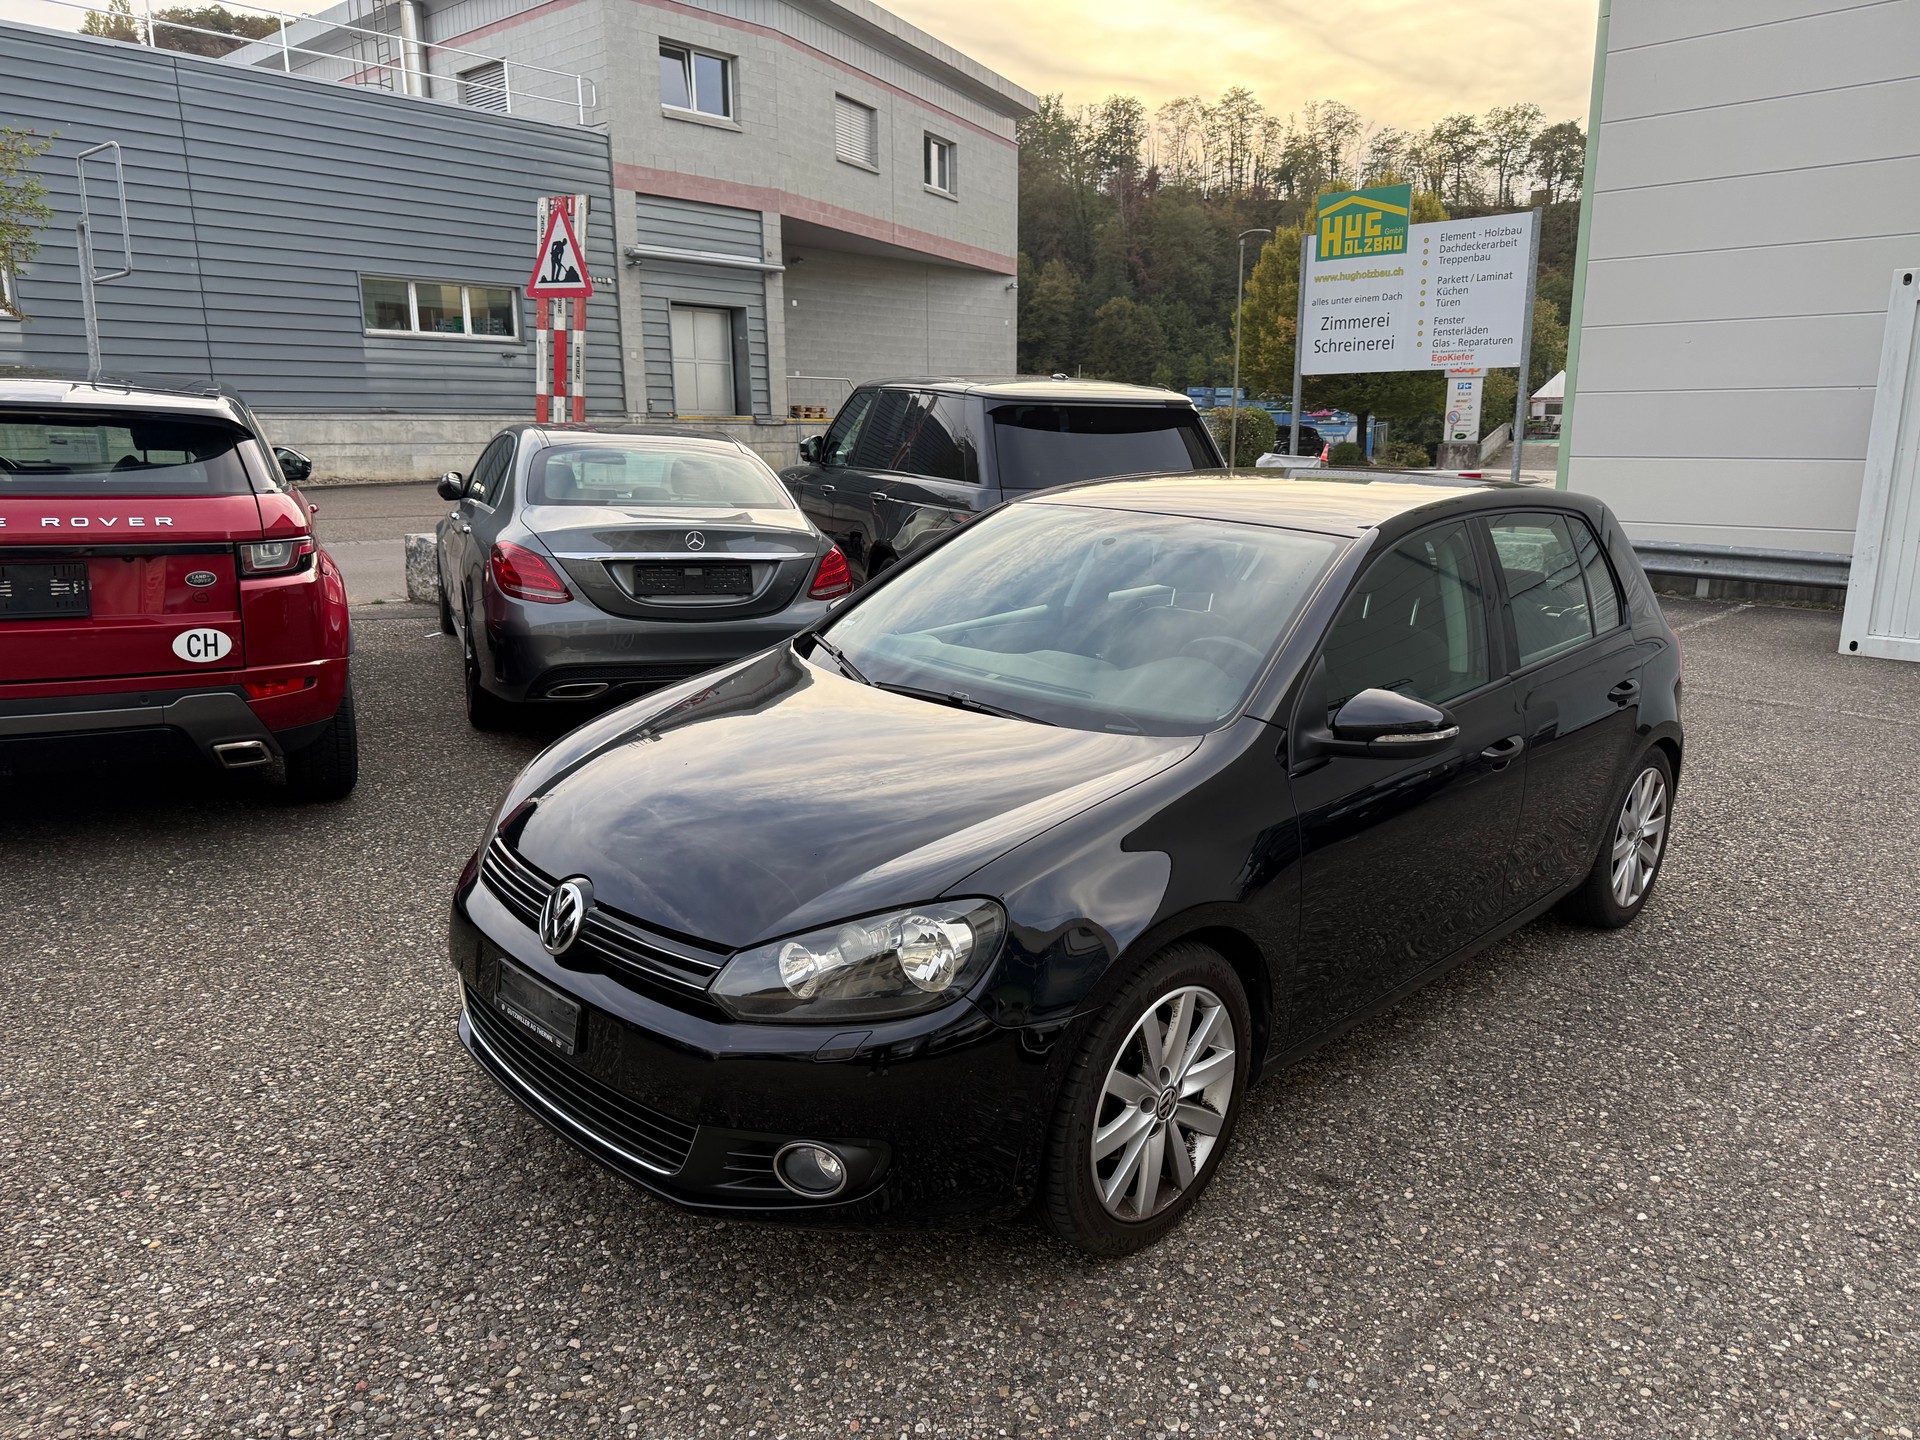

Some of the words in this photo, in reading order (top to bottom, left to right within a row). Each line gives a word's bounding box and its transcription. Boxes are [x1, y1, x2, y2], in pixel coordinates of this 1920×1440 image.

[1384, 227, 1404, 235] GmbH
[1440, 231, 1476, 242] Element
[1484, 227, 1522, 238] Holzbau
[1439, 238, 1518, 253] Dachdeckerarbeit
[1439, 253, 1491, 266] Treppenbau
[1314, 266, 1404, 283] www.hugholzbau.ch
[1437, 275, 1469, 285] Parkett
[1476, 271, 1513, 282] Laminat
[1436, 286, 1469, 296] Küchen
[1311, 298, 1329, 306] alles
[1331, 296, 1352, 305] unter
[1354, 294, 1380, 303] einem
[1382, 291, 1403, 301] Dach
[1436, 298, 1461, 307] Türen
[1320, 312, 1390, 331] Zimmerei
[1433, 316, 1465, 325] Fenster
[1433, 326, 1489, 337] Fensterläden
[1314, 334, 1395, 353] Schreinerei
[1432, 338, 1450, 348] Glas
[1458, 337, 1513, 348] Reparaturen
[1431, 353, 1474, 363] EgoKiefer
[41, 517, 173, 527] ROVER
[187, 633, 218, 657] CH
